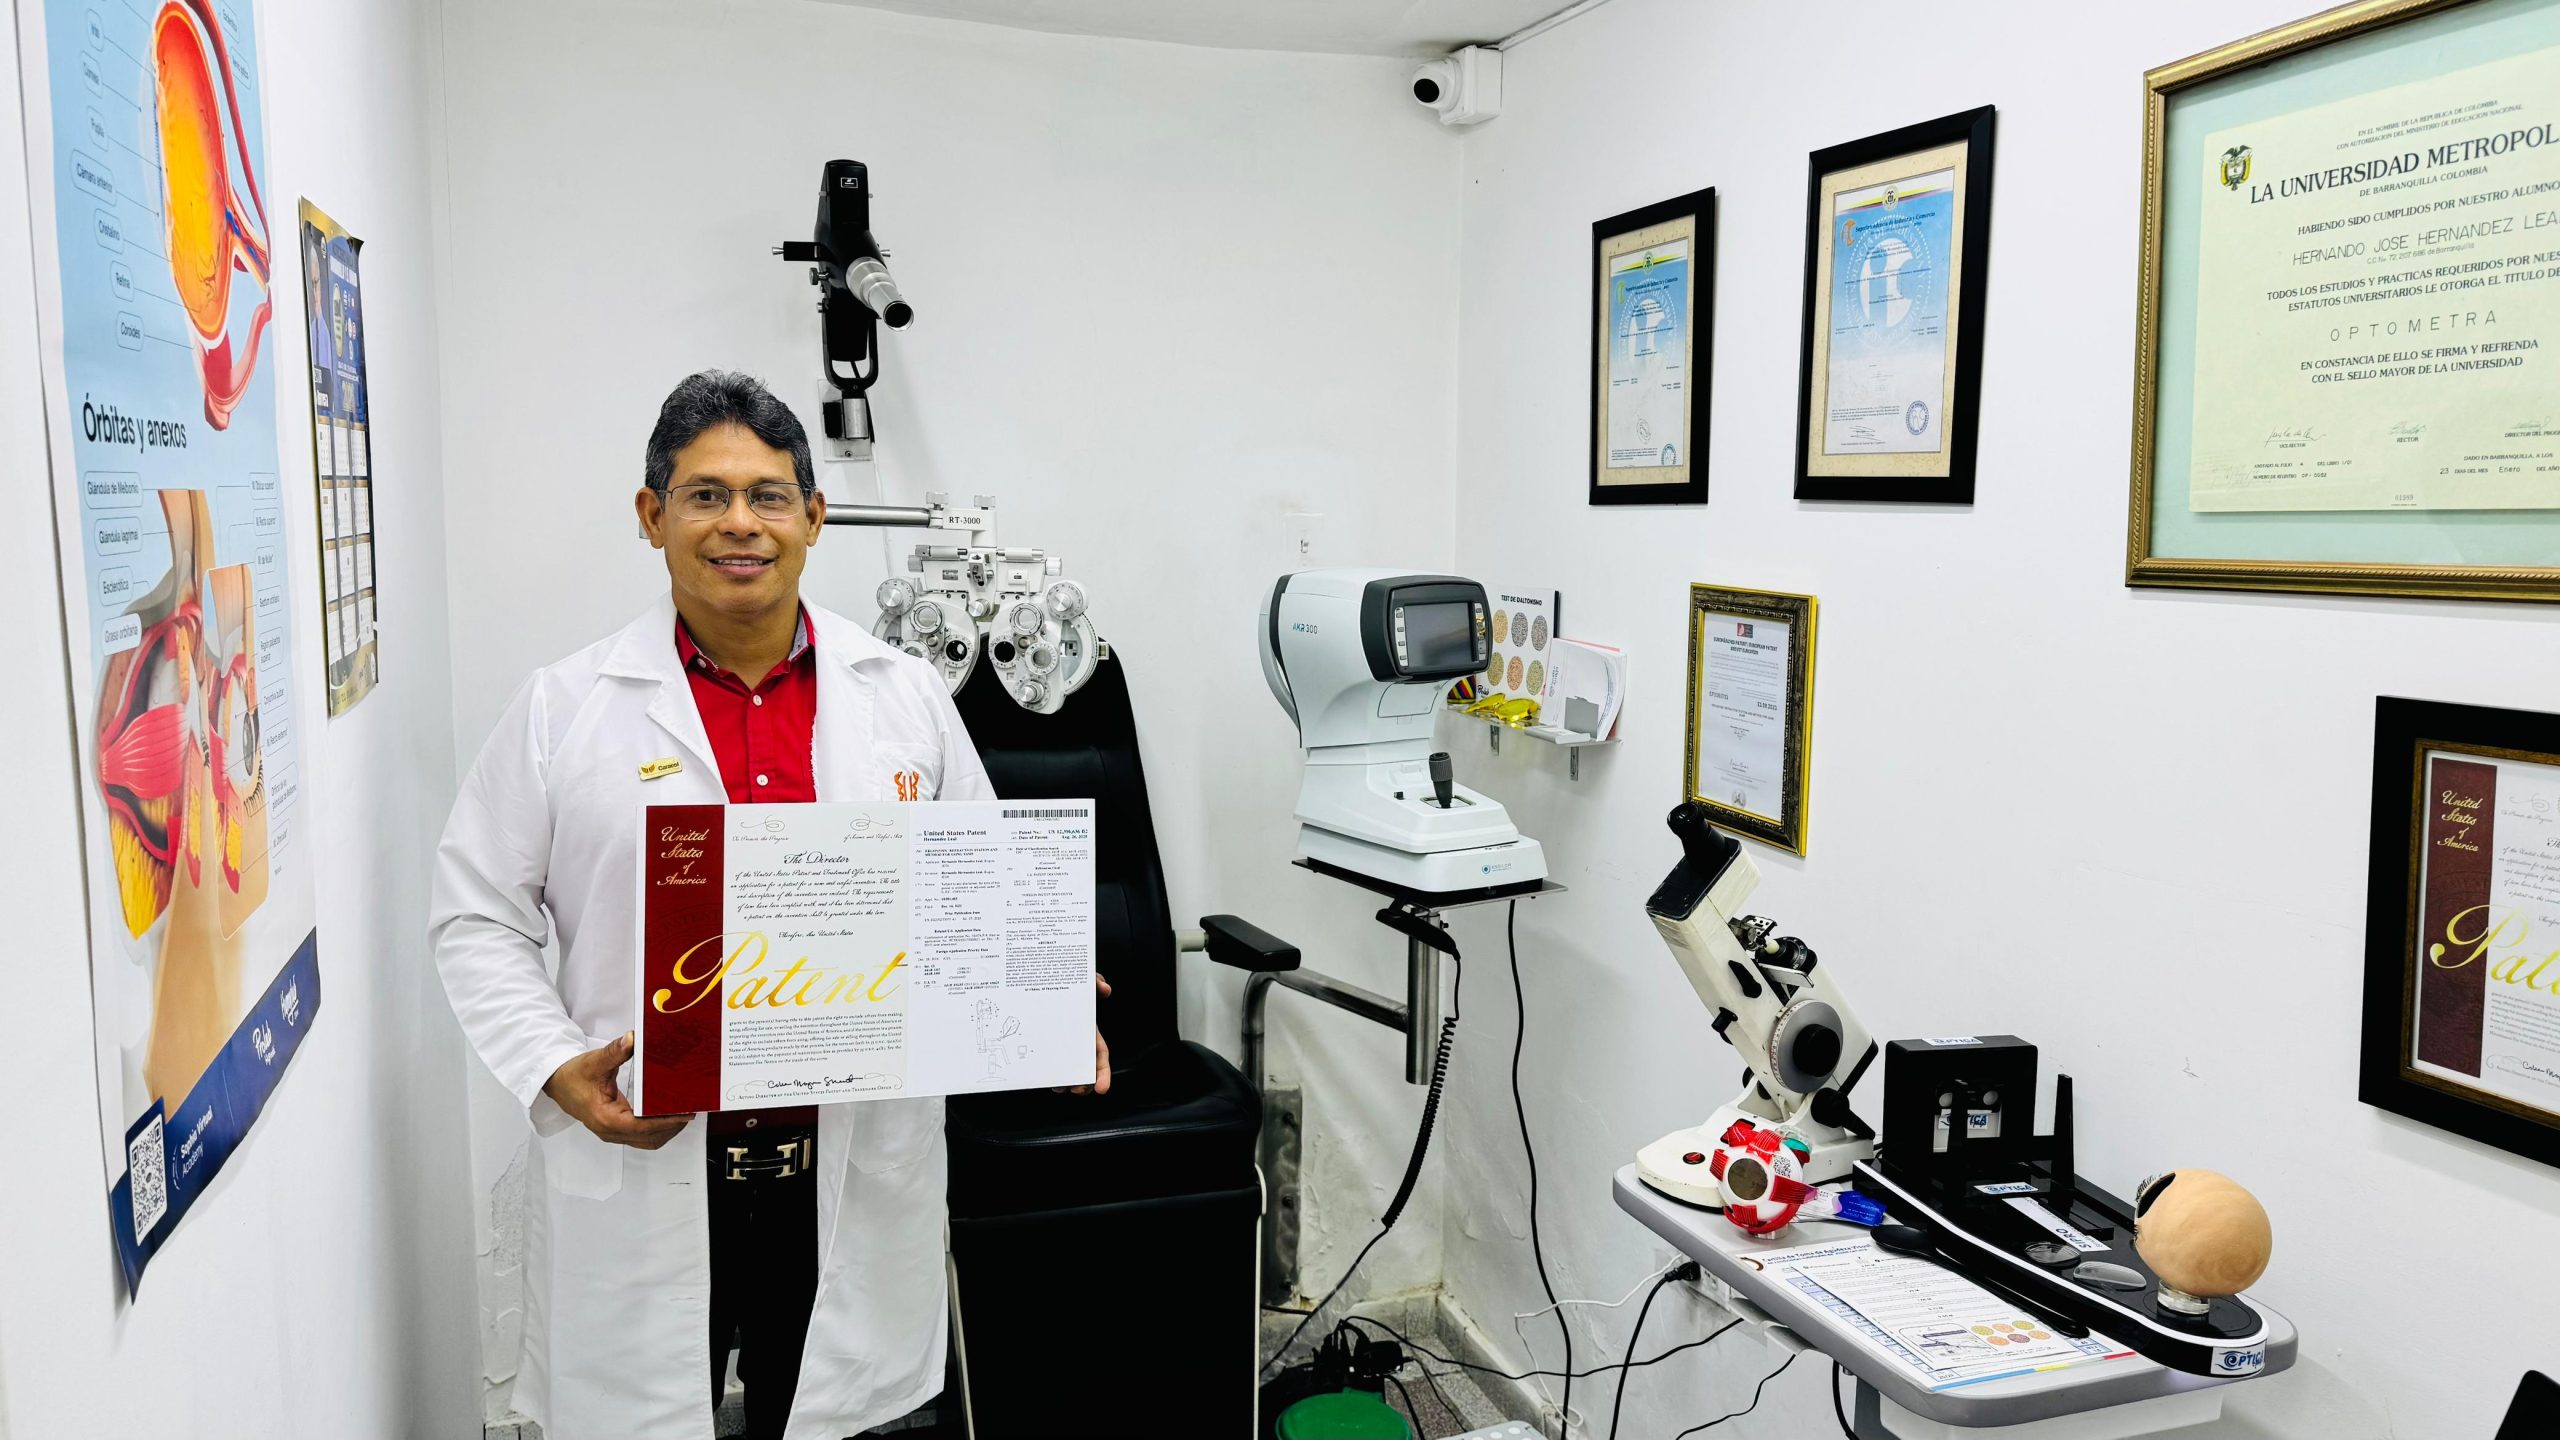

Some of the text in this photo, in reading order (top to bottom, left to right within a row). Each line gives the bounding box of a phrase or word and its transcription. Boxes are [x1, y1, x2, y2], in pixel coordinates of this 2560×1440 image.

[2250, 123, 2560, 204] LA UNIVERSIDAD METROPOL
[2360, 165, 2488, 197] DE BARRANQUILLA COLOMBIA
[2298, 219, 2345, 235] HABIENDO
[2347, 214, 2371, 226] SIDO
[2373, 203, 2431, 222] CUMPLIDOS
[2433, 199, 2455, 212] POR
[2458, 189, 2509, 207] NUESTRO
[2292, 210, 2560, 266] HERNANDO JOSE HERNANDEZ LEA
[2267, 288, 2298, 301] TODOS
[2300, 285, 2318, 296] LOS
[2320, 278, 2366, 293] ESTUDIOS
[2368, 277, 2376, 286] Y
[2377, 269, 2433, 285] PRACTICAS
[2435, 259, 2504, 278] REQUERIDOS
[2506, 255, 2530, 267] POR
[2288, 297, 2341, 312] ESTATUTOS
[2343, 286, 2423, 304] UNIVERSITARIOS
[2425, 284, 2437, 294] LE
[2440, 277, 2485, 292] OTORGA
[2488, 275, 2501, 286] EL
[2503, 269, 2544, 284] TITULO
[2330, 310, 2497, 342] OPTOMETRA
[2300, 339, 2539, 371] EN CONSTANCIA DE ELLO SE FIRMA Y REFRENDA
[2311, 356, 2524, 384] CON EL SELLO MAYOR DE LA UNIVERSIDAD
[83, 392, 187, 454] Órbitas y anexos
[2498, 466, 2521, 474] Enero
[949, 516, 981, 525] RT-3000
[2442, 790, 2483, 809] United
[2441, 808, 2477, 825] States
[660, 826, 708, 844] United
[2437, 836, 2479, 852] America
[2459, 827, 2469, 840] of
[660, 844, 704, 860] States
[784, 850, 850, 865] The Director
[656, 872, 708, 887] America
[682, 861, 692, 879] of
[652, 930, 909, 1014] Patent
[180, 1104, 214, 1160] Sophia Virtual
[182, 1141, 204, 1178] Academy
